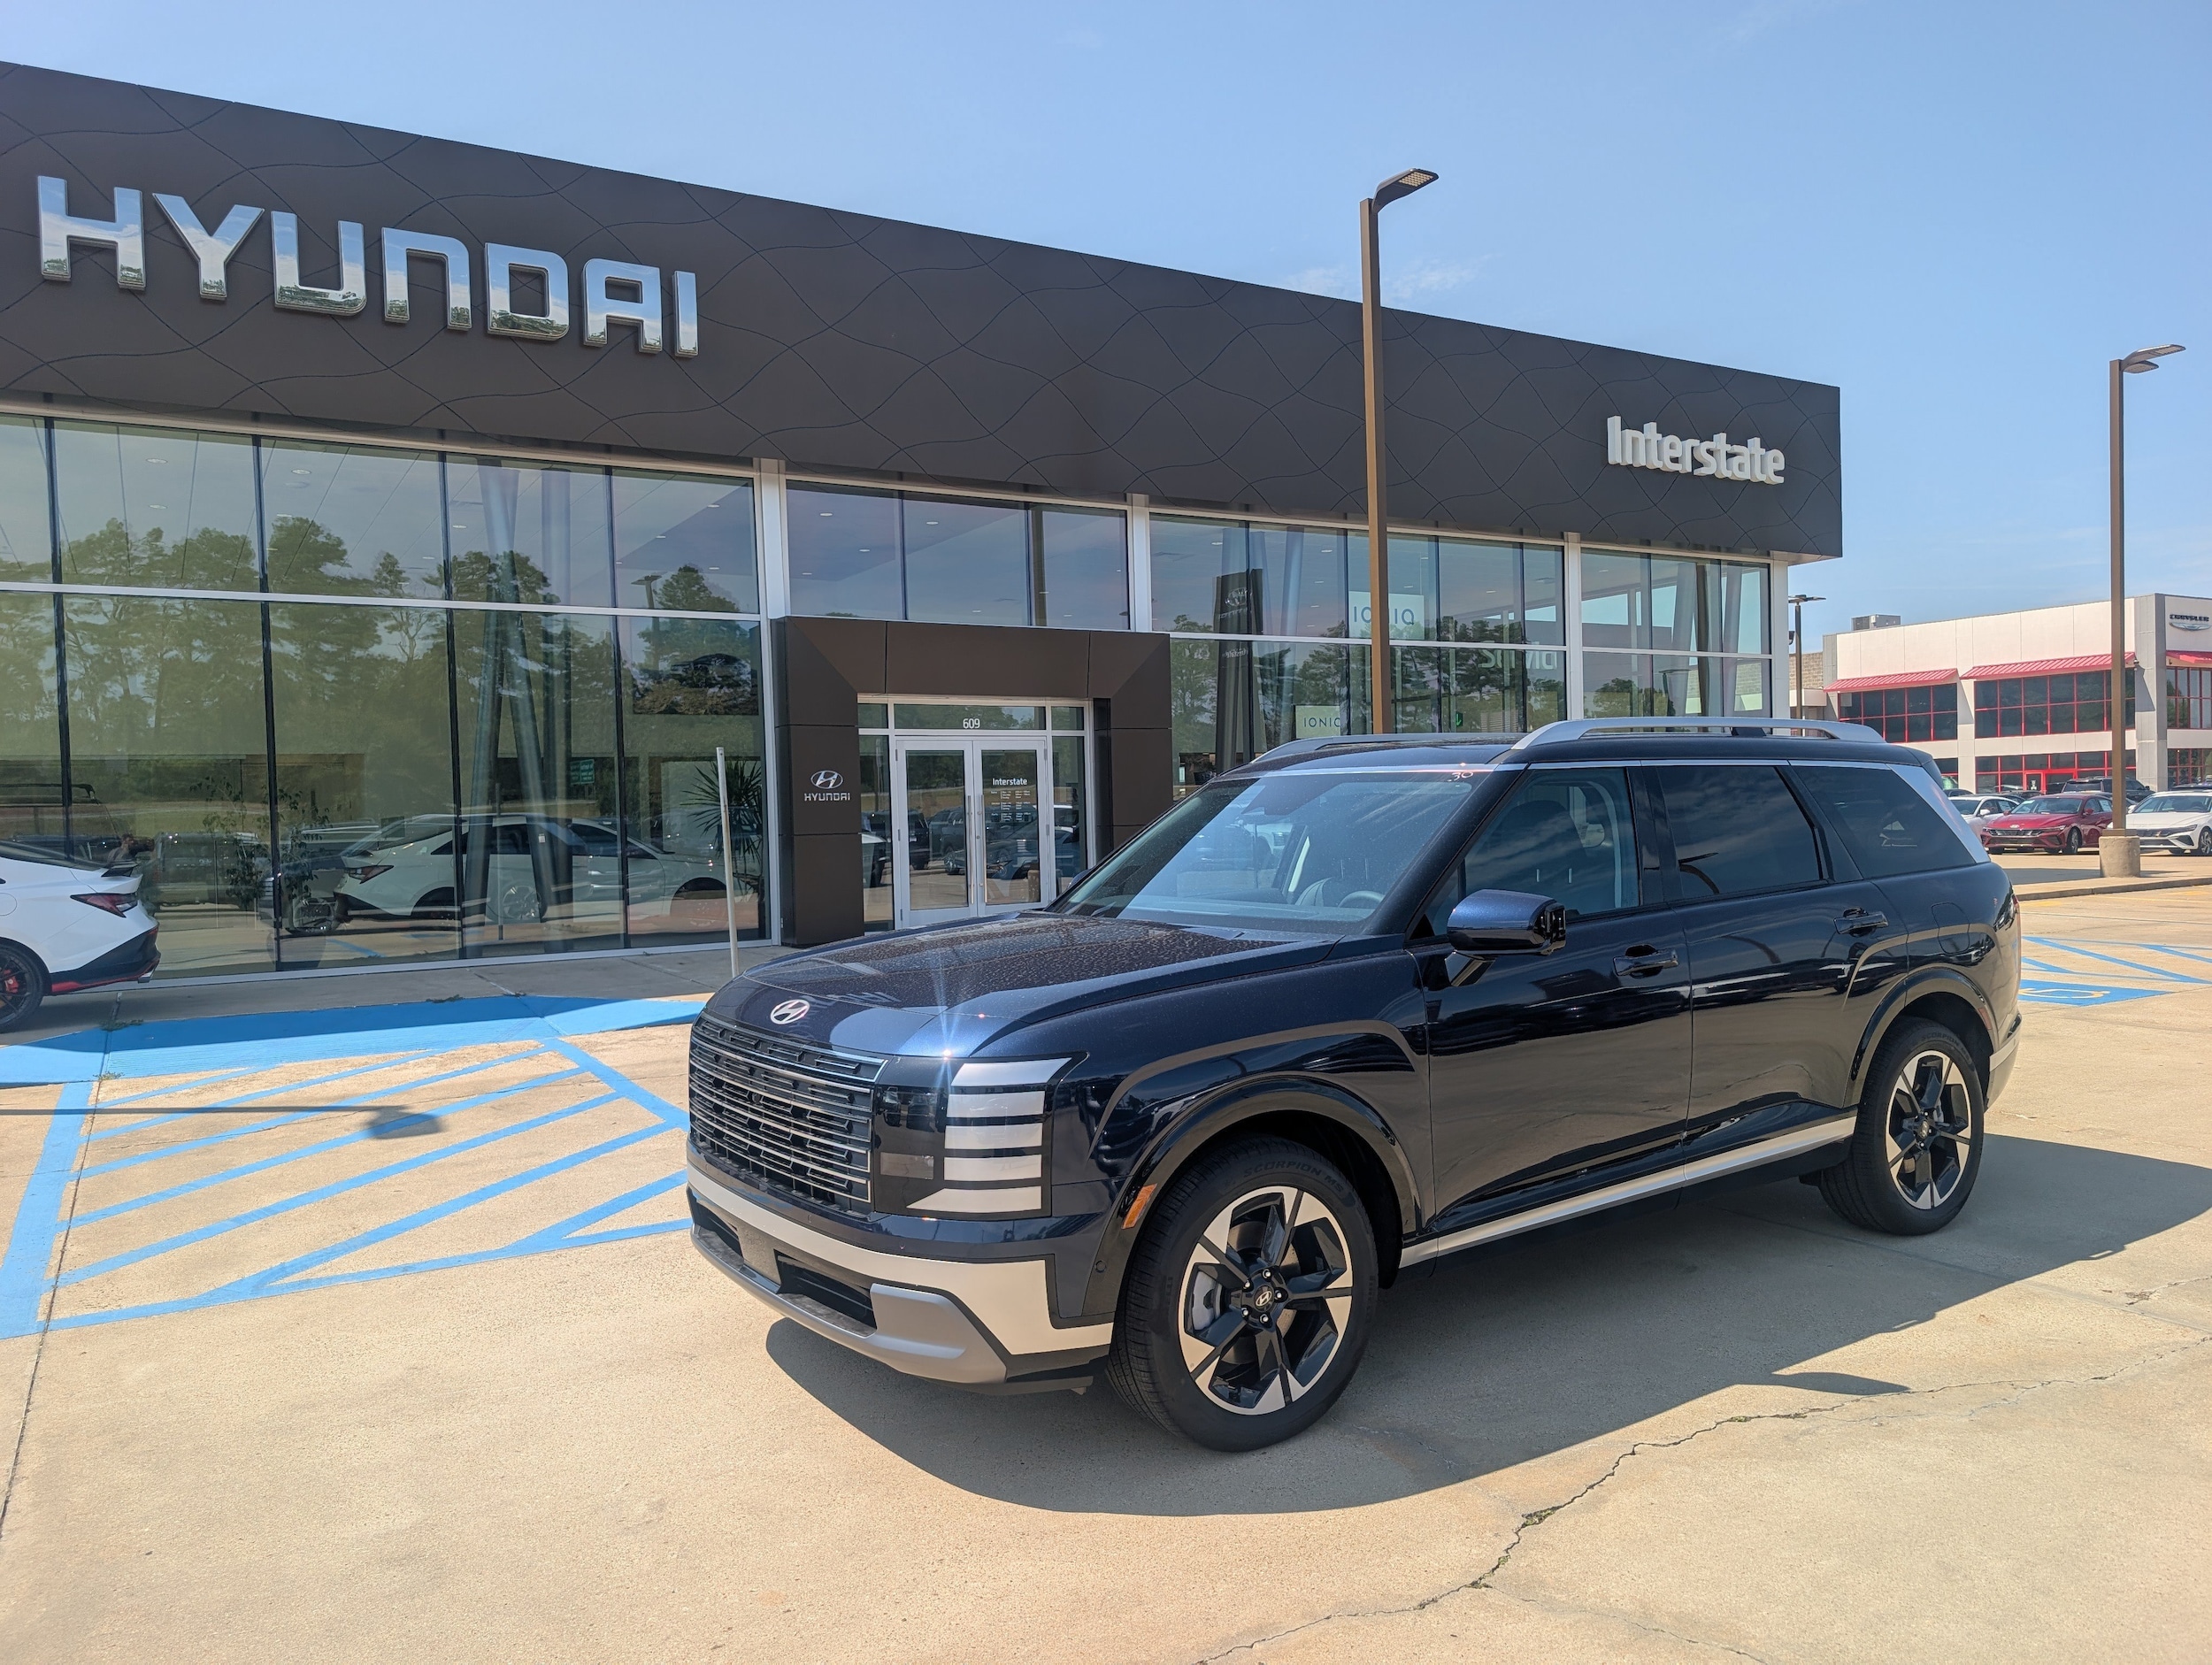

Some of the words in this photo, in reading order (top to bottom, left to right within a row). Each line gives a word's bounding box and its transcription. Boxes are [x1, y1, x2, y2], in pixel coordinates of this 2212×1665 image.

[37, 175, 699, 357] HYUNDAI
[1607, 415, 1786, 485] Interstate
[1354, 606, 1415, 625] IOIQ
[963, 718, 980, 729] 609
[804, 792, 850, 802] HYUNDAI
[1243, 1161, 1322, 1178] SCORPION
[1325, 1175, 1344, 1191] MS
